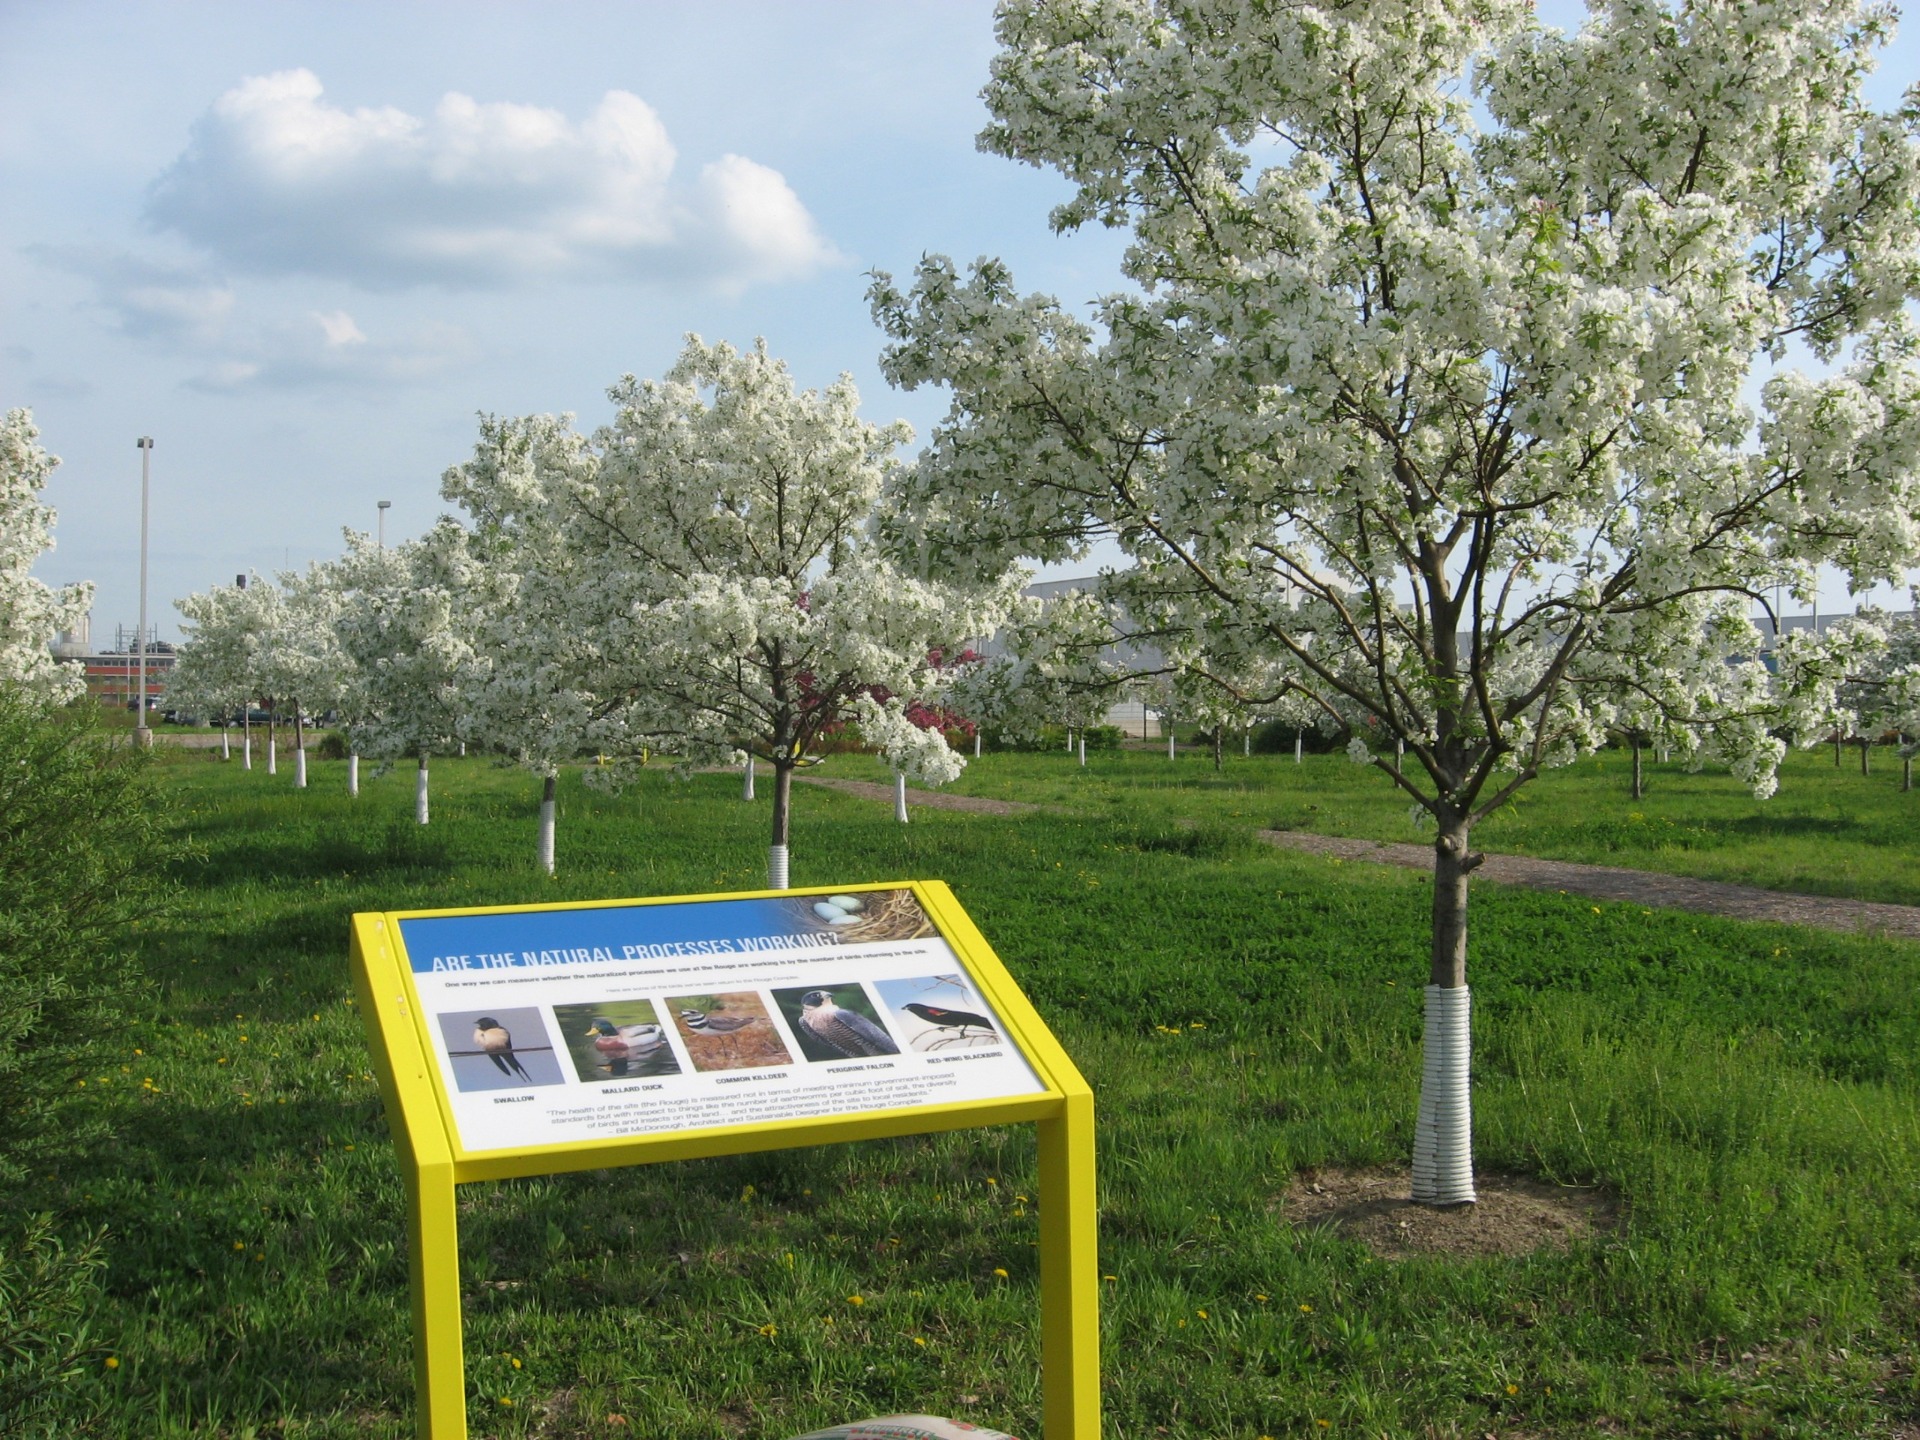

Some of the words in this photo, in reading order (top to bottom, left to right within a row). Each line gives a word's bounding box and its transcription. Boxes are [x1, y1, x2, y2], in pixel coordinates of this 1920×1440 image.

[432, 955, 473, 973] ARE
[475, 952, 518, 970] THE
[521, 946, 620, 966] NATURAL
[622, 938, 736, 960] PROCESSES
[737, 932, 839, 952] WORKING?
[444, 981, 460, 989] One
[507, 976, 540, 984] measure
[541, 974, 571, 982] whether
[572, 972, 585, 980] the
[586, 970, 627, 979] naturalized
[628, 968, 665, 977] processes
[750, 960, 779, 968] working
[778, 958, 786, 966] is
[786, 958, 796, 966] by
[809, 955, 835, 963] number
[843, 953, 862, 961] birds
[862, 951, 893, 959] returning
[826, 1064, 865, 1075] PERIGRINE
[865, 1061, 895, 1071] FALCON
[926, 1054, 963, 1065] RED-WING
[962, 1050, 1003, 1061] BLACKBIRD
[545, 1108, 567, 1117] "The
[568, 1105, 595, 1115] health
[596, 1104, 606, 1113] of
[607, 1103, 622, 1112] the
[623, 1102, 639, 1110] site
[640, 1100, 657, 1109] (the
[658, 1097, 689, 1107] Rouge)
[690, 1096, 698, 1104] is
[699, 1091, 741, 1103] measured
[742, 1090, 756, 1099] not
[758, 1089, 766, 1098] in
[767, 1088, 791, 1097] terms
[792, 1086, 801, 1095] of
[802, 1083, 835, 1093] meeting
[835, 1080, 872, 1090] minimum
[873, 1071, 955, 1087] government-imposed
[601, 1084, 640, 1095] MALLARD
[641, 1082, 663, 1092] DUCK
[715, 1075, 751, 1085] COMMON
[751, 1071, 788, 1082] KILLDEER
[493, 1094, 535, 1105] SWALLOW
[551, 1113, 595, 1125] standards
[596, 1112, 611, 1121] but
[612, 1110, 631, 1119] with
[633, 1107, 665, 1117] respect
[666, 1106, 677, 1114] to
[678, 1104, 704, 1113] things
[705, 1102, 719, 1110] like
[720, 1101, 735, 1109] the
[736, 1098, 767, 1107] number
[769, 1095, 778, 1104] of
[779, 1092, 828, 1103] earthworms
[829, 1088, 842, 1099] per
[844, 1087, 866, 1097] cubic
[867, 1086, 883, 1094] foot
[884, 1084, 893, 1093] of
[894, 1083, 910, 1092] soil,
[911, 1082, 925, 1090] the
[926, 1078, 957, 1088] diversity
[586, 1121, 596, 1129] of
[597, 1119, 620, 1129] birds
[621, 1117, 639, 1126] and
[640, 1115, 671, 1124] insects
[672, 1113, 684, 1121] on
[685, 1112, 700, 1120] the
[701, 1109, 728, 1118] land...
[730, 1106, 747, 1116] and
[748, 1106, 762, 1114] the
[764, 1100, 820, 1112] attractiveness
[821, 1098, 830, 1107] of
[831, 1097, 845, 1105] the
[846, 1096, 861, 1104] site
[861, 1095, 871, 1103] to
[871, 1092, 891, 1101] local
[892, 1087, 932, 1099] residents."
[615, 1126, 629, 1135] Bill
[630, 1121, 685, 1133] McDonough,
[688, 1116, 725, 1127] Architect
[727, 1114, 744, 1124] and
[745, 1110, 793, 1122] Sustainable
[794, 1107, 830, 1117] Designer
[832, 1105, 843, 1113] for
[845, 1104, 859, 1112] the
[859, 1101, 886, 1110] Rouge
[887, 1097, 922, 1107] Complex
